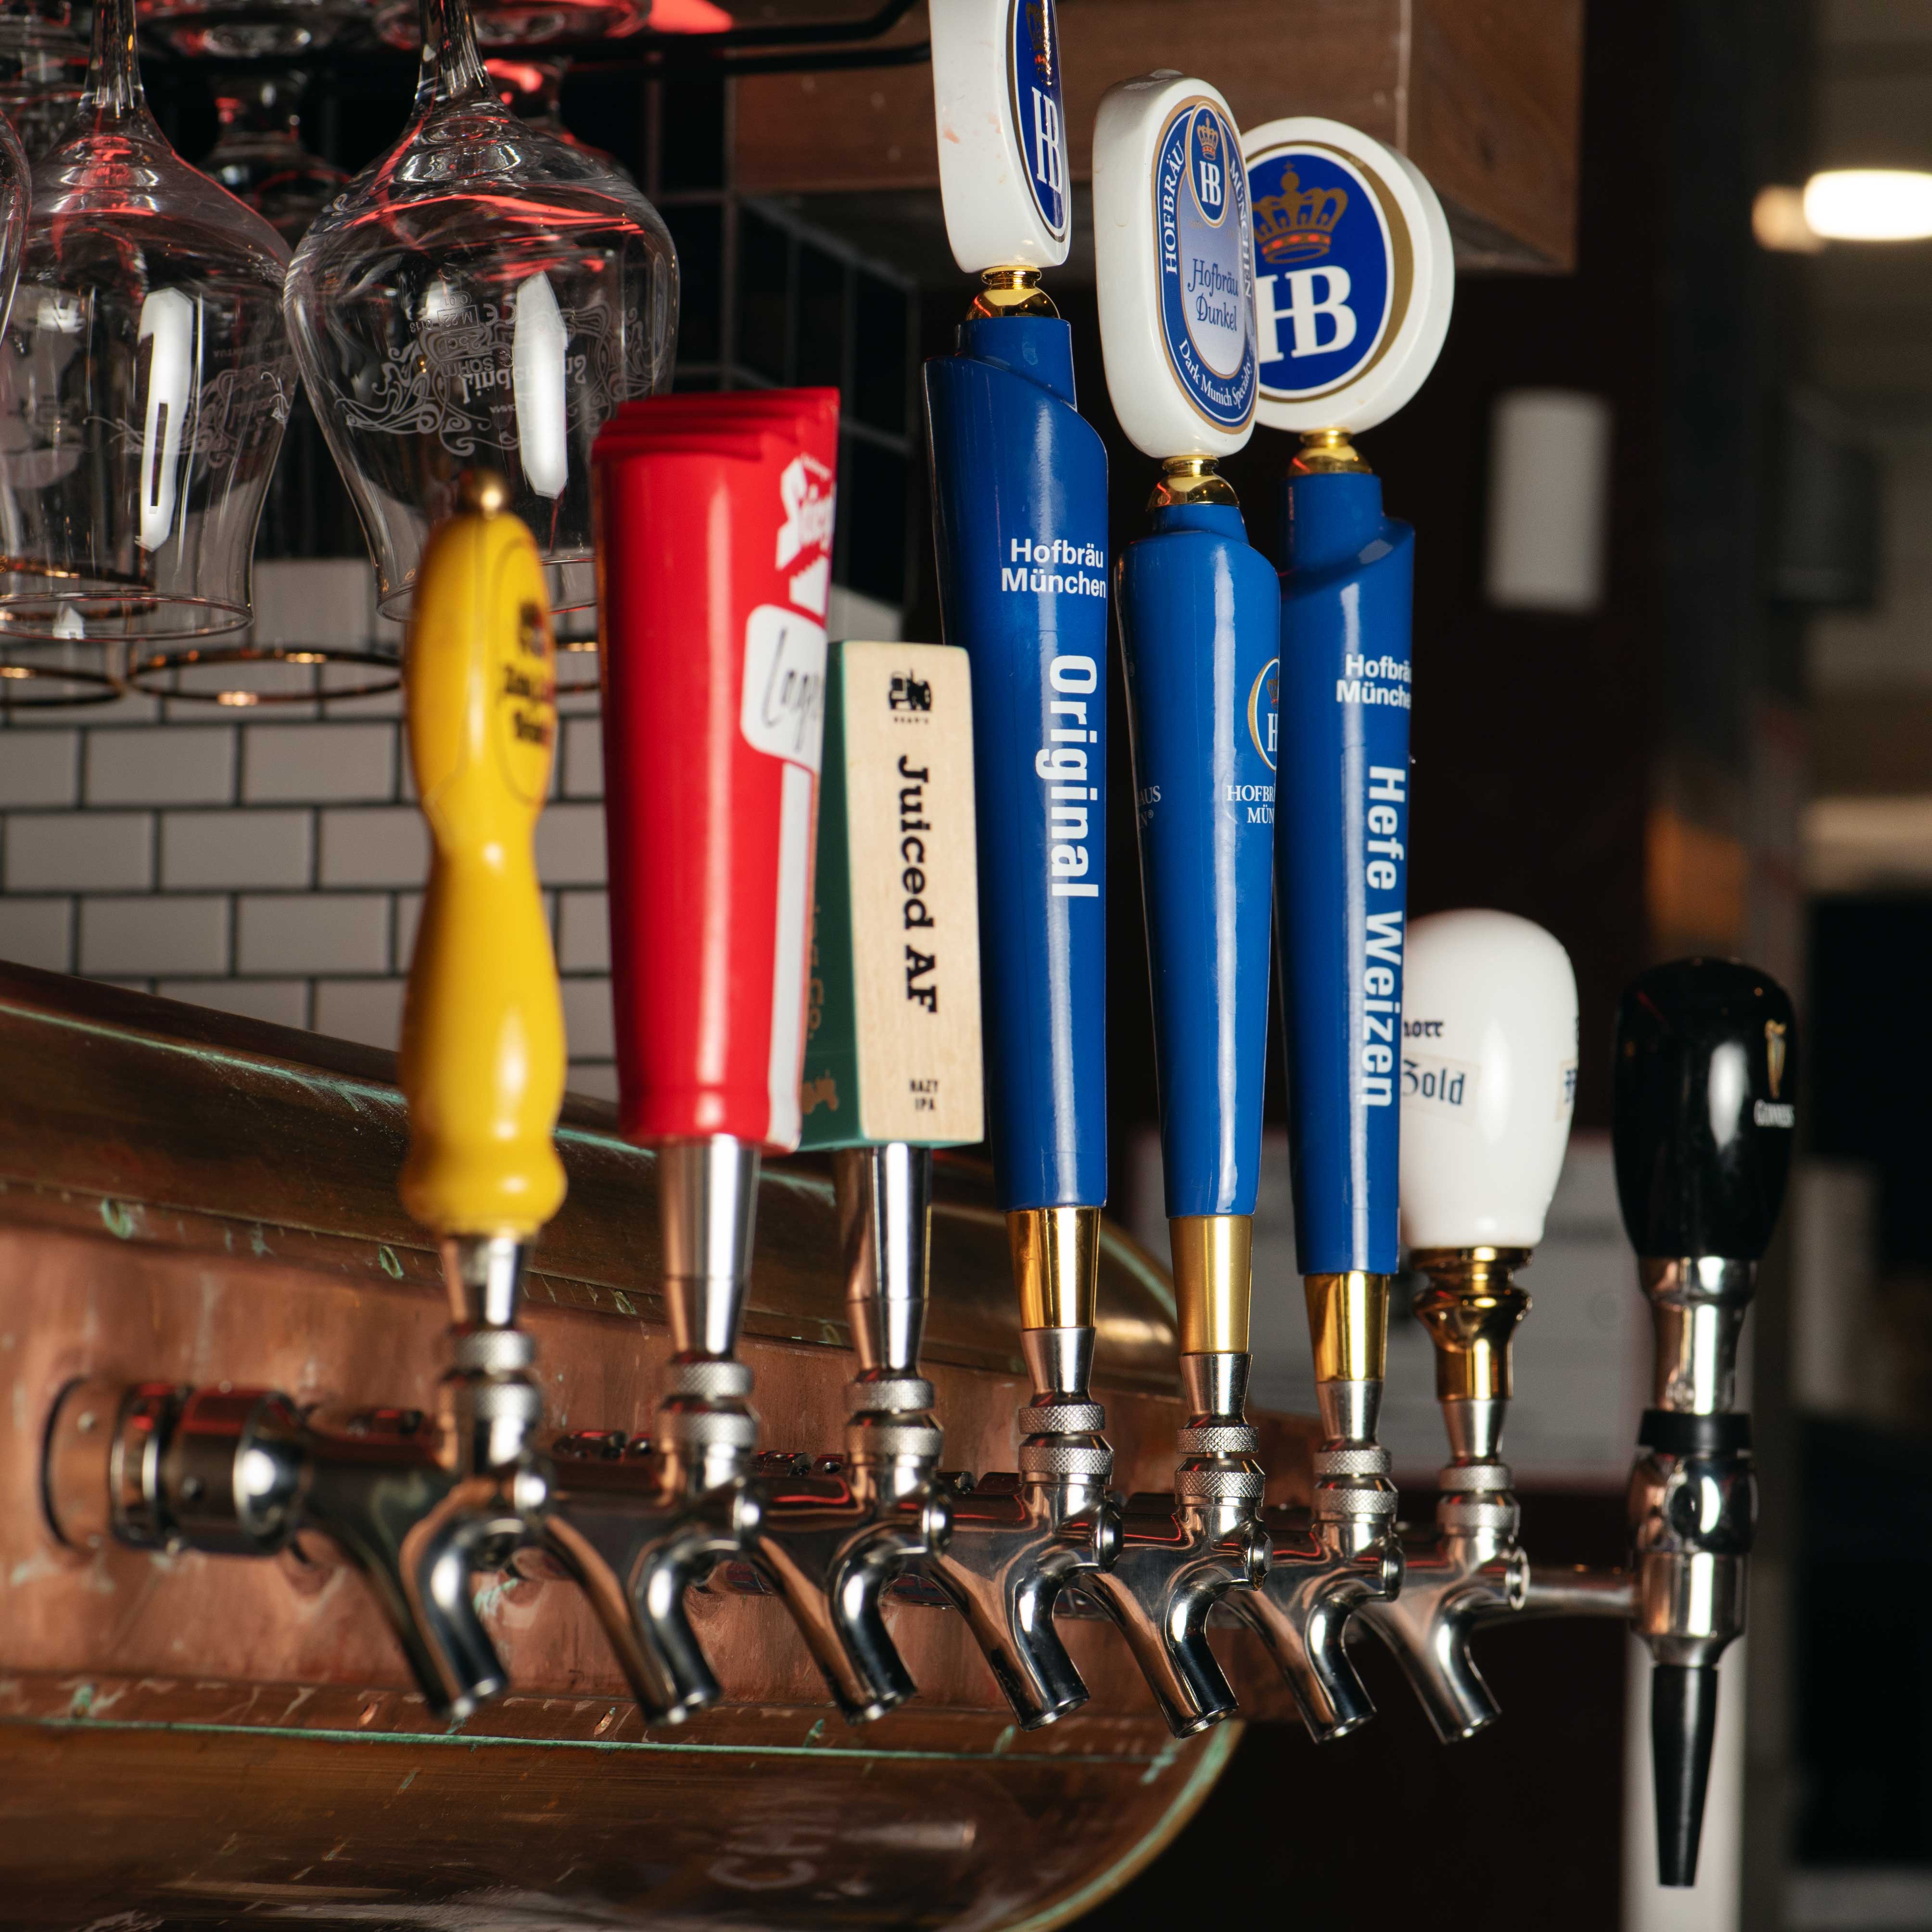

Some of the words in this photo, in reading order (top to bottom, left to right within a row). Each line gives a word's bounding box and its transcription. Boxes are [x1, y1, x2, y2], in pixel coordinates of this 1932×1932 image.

[1031, 86, 1063, 194] HB
[1162, 140, 1185, 275] HOFBRÄU
[1199, 161, 1221, 206] HB
[1187, 258, 1239, 297] Hofbräu
[1195, 292, 1237, 331] Dunkel
[1256, 265, 1357, 364] HB
[1179, 338, 1201, 385] Dark
[1200, 374, 1233, 407] Munich
[1001, 568, 1106, 598] München
[1011, 538, 1104, 569] Hofbräu
[1036, 655, 1099, 897] Original
[897, 754, 934, 930] Juiced
[1366, 765, 1406, 890] Hefe
[905, 944, 939, 1014] AF
[1360, 910, 1403, 1107] Weizen
[915, 1097, 936, 1112] IPA
